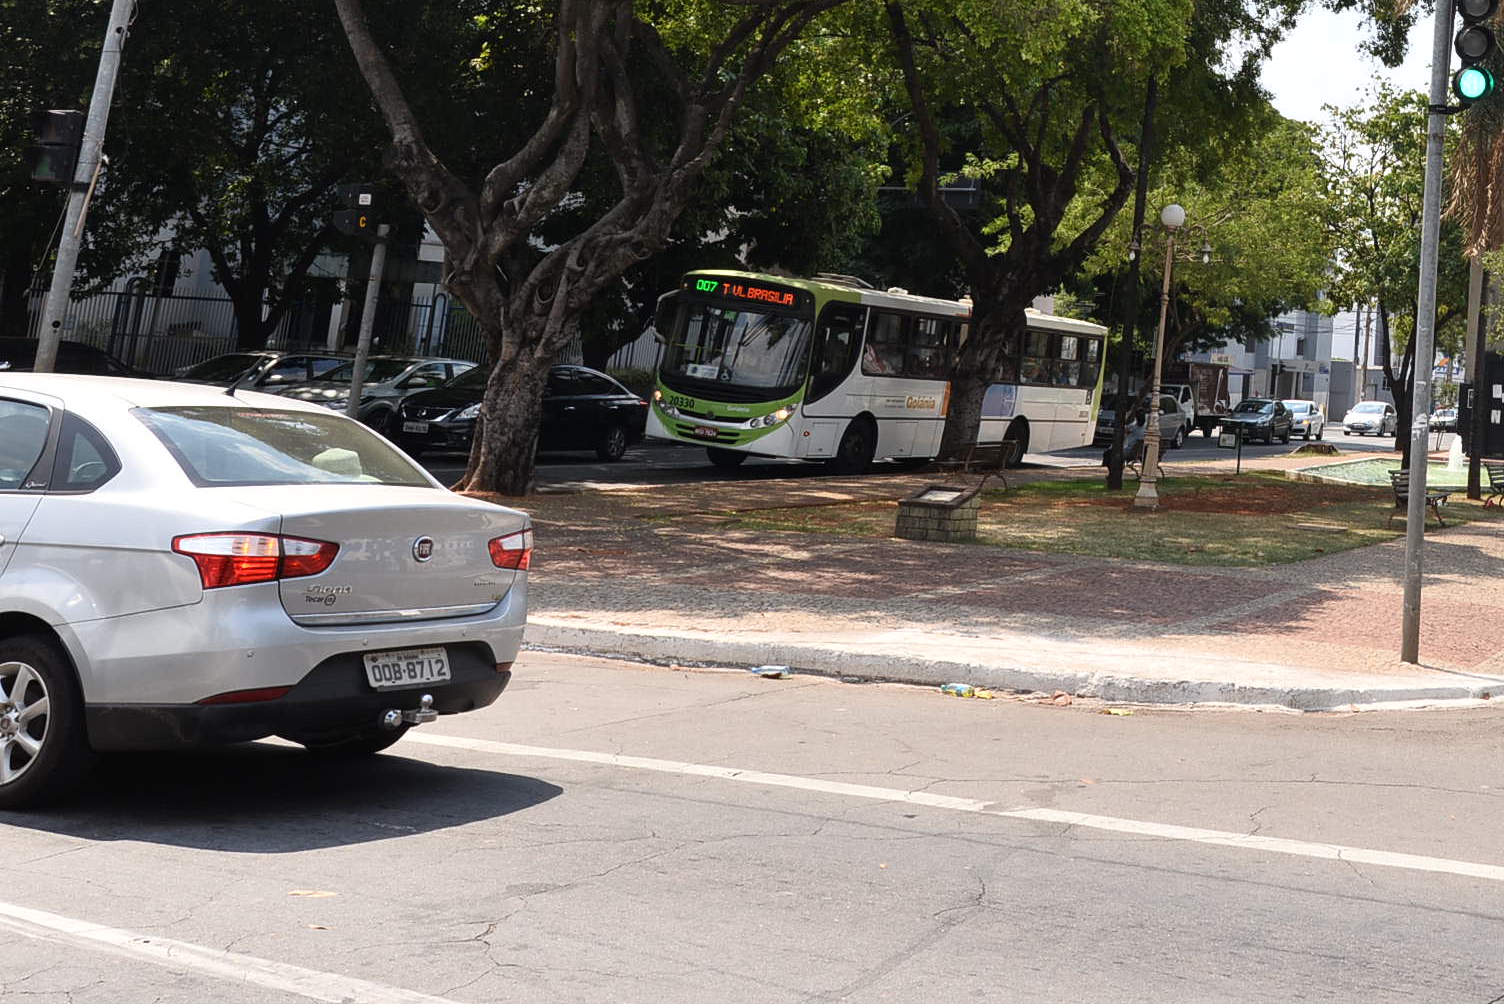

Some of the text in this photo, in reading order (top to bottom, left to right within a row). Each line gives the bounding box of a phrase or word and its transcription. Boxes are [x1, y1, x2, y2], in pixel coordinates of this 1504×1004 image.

[696, 279, 719, 292] 007
[723, 283, 731, 295] T
[747, 287, 794, 305] BRASILIA
[668, 395, 695, 409] 20330
